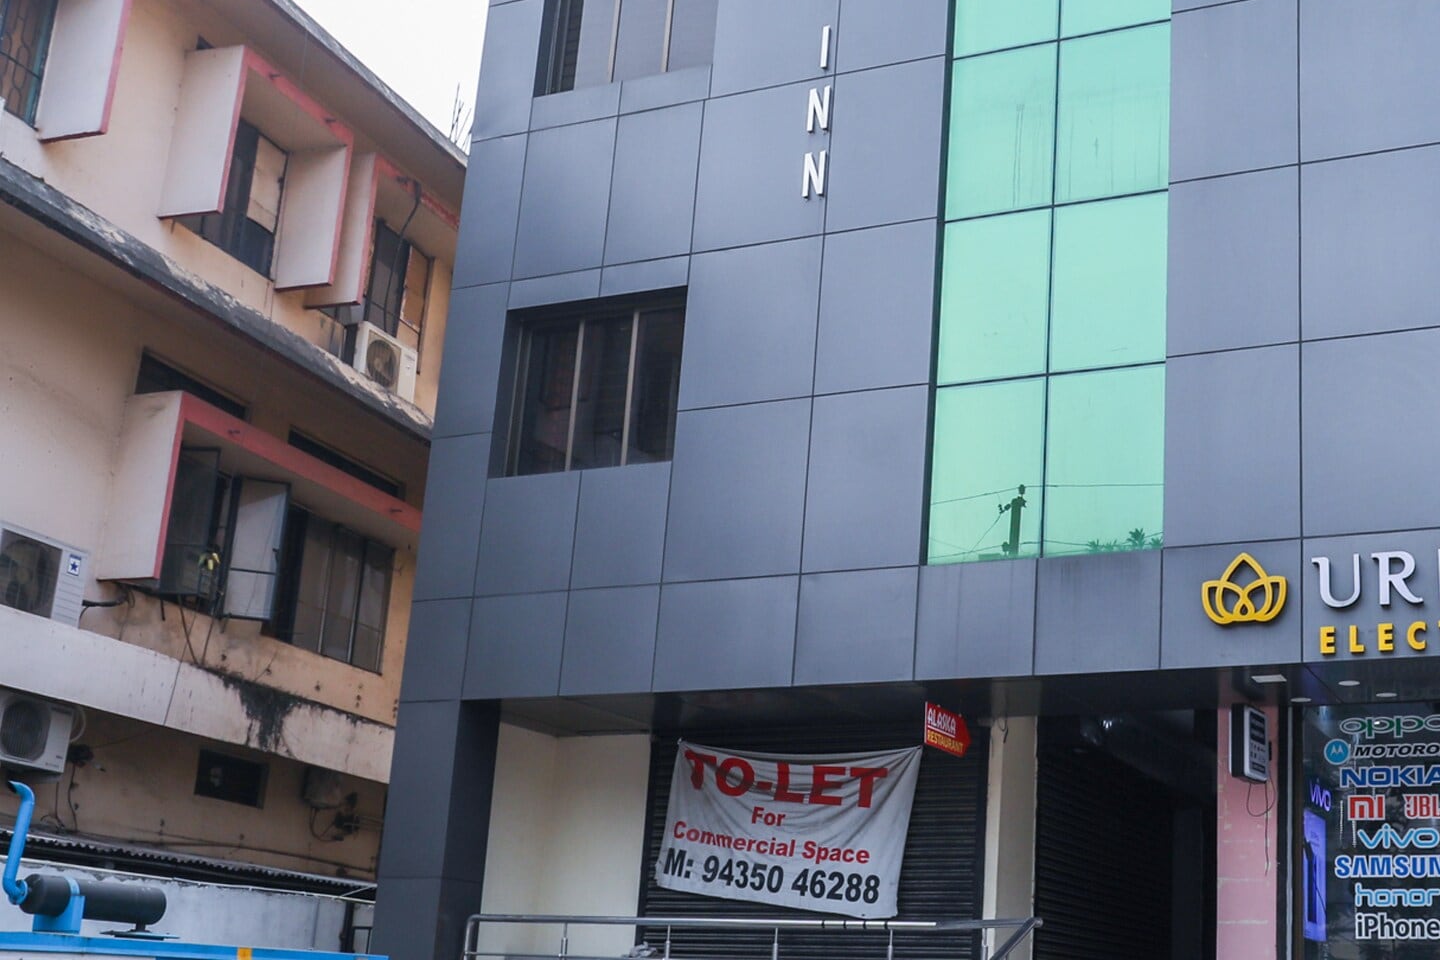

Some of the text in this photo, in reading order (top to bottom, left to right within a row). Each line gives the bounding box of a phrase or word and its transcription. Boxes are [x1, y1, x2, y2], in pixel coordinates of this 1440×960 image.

[801, 24, 832, 200] INN
[927, 707, 957, 736] ALASKA
[684, 748, 888, 809] TO-LET
[751, 806, 786, 827] For
[673, 820, 870, 865] Commercial Space
[1357, 823, 1440, 849] vivo
[663, 847, 880, 905] M: 94350 46288
[1355, 882, 1440, 907] honor
